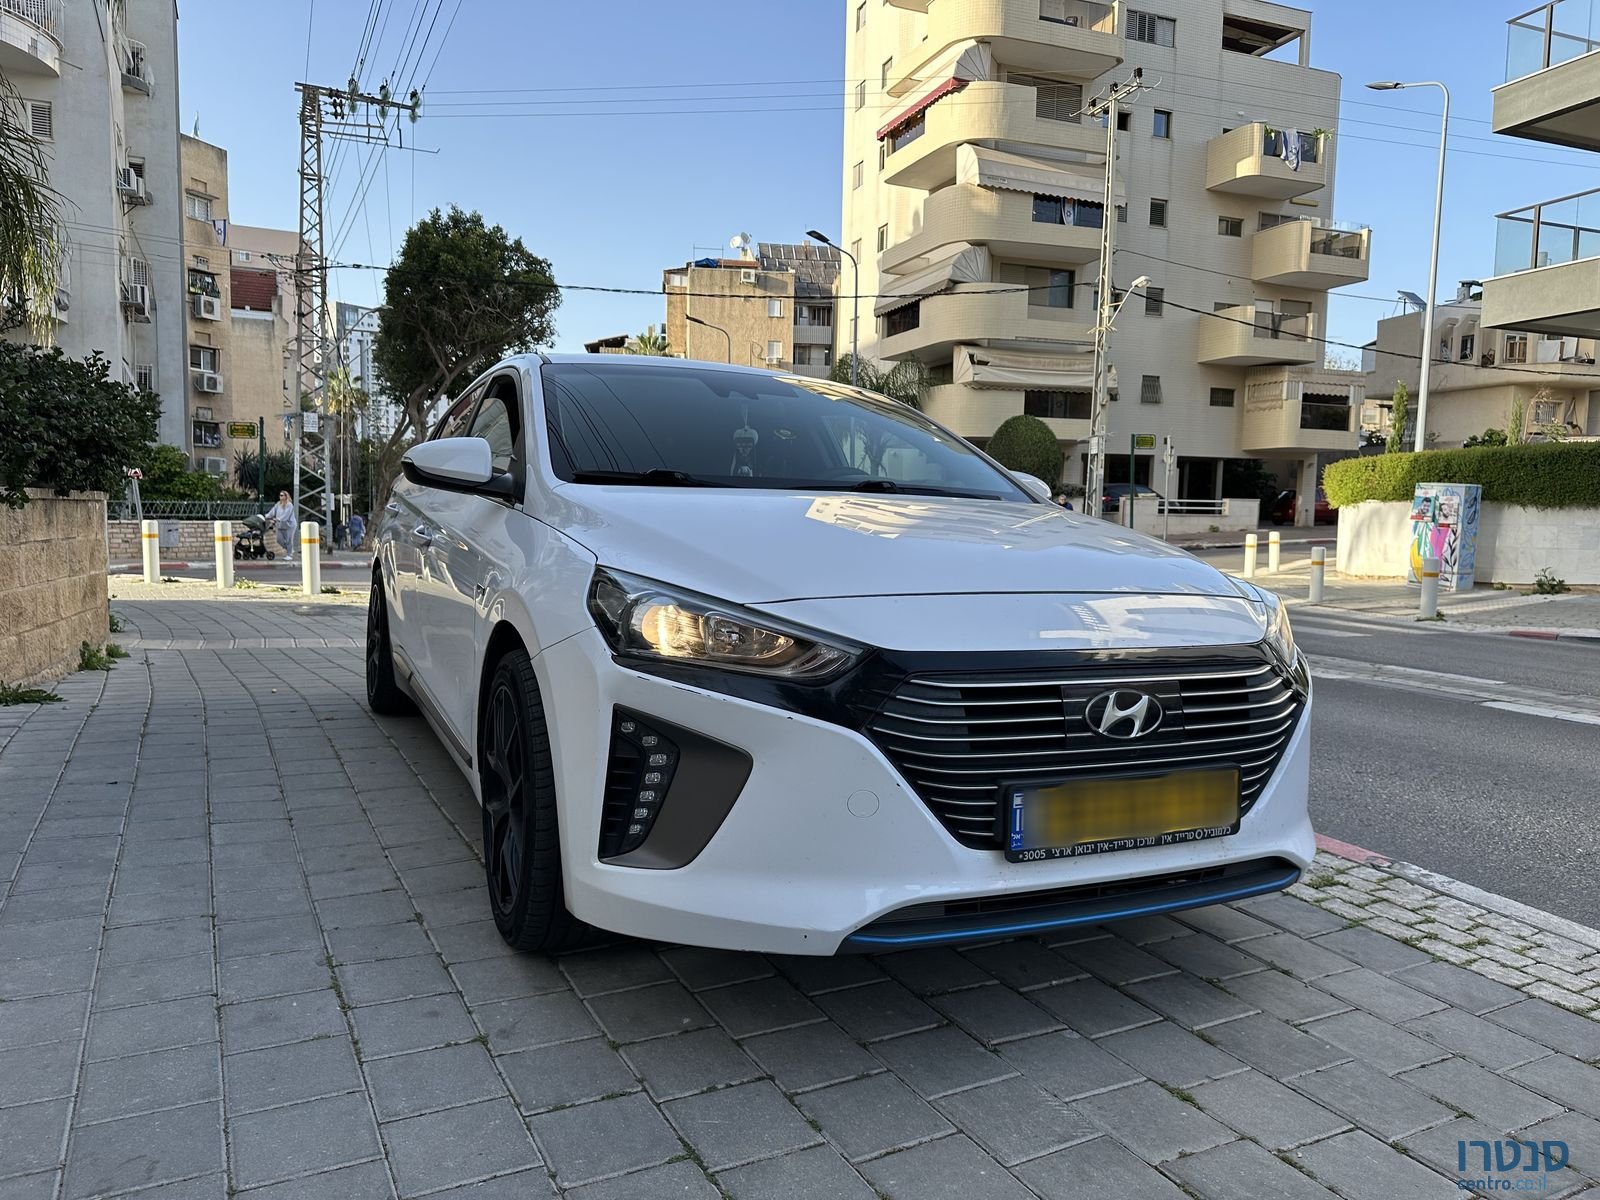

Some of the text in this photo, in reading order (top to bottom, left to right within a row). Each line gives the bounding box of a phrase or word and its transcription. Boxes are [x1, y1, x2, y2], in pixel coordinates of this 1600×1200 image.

[1174, 831, 1195, 842] טרייד
[1203, 826, 1231, 838] כלמוביל
[1137, 837, 1155, 847] מרכז
[1161, 834, 1172, 845] אין
[1052, 847, 1072, 857] ארצי
[1074, 843, 1094, 855] יבואן
